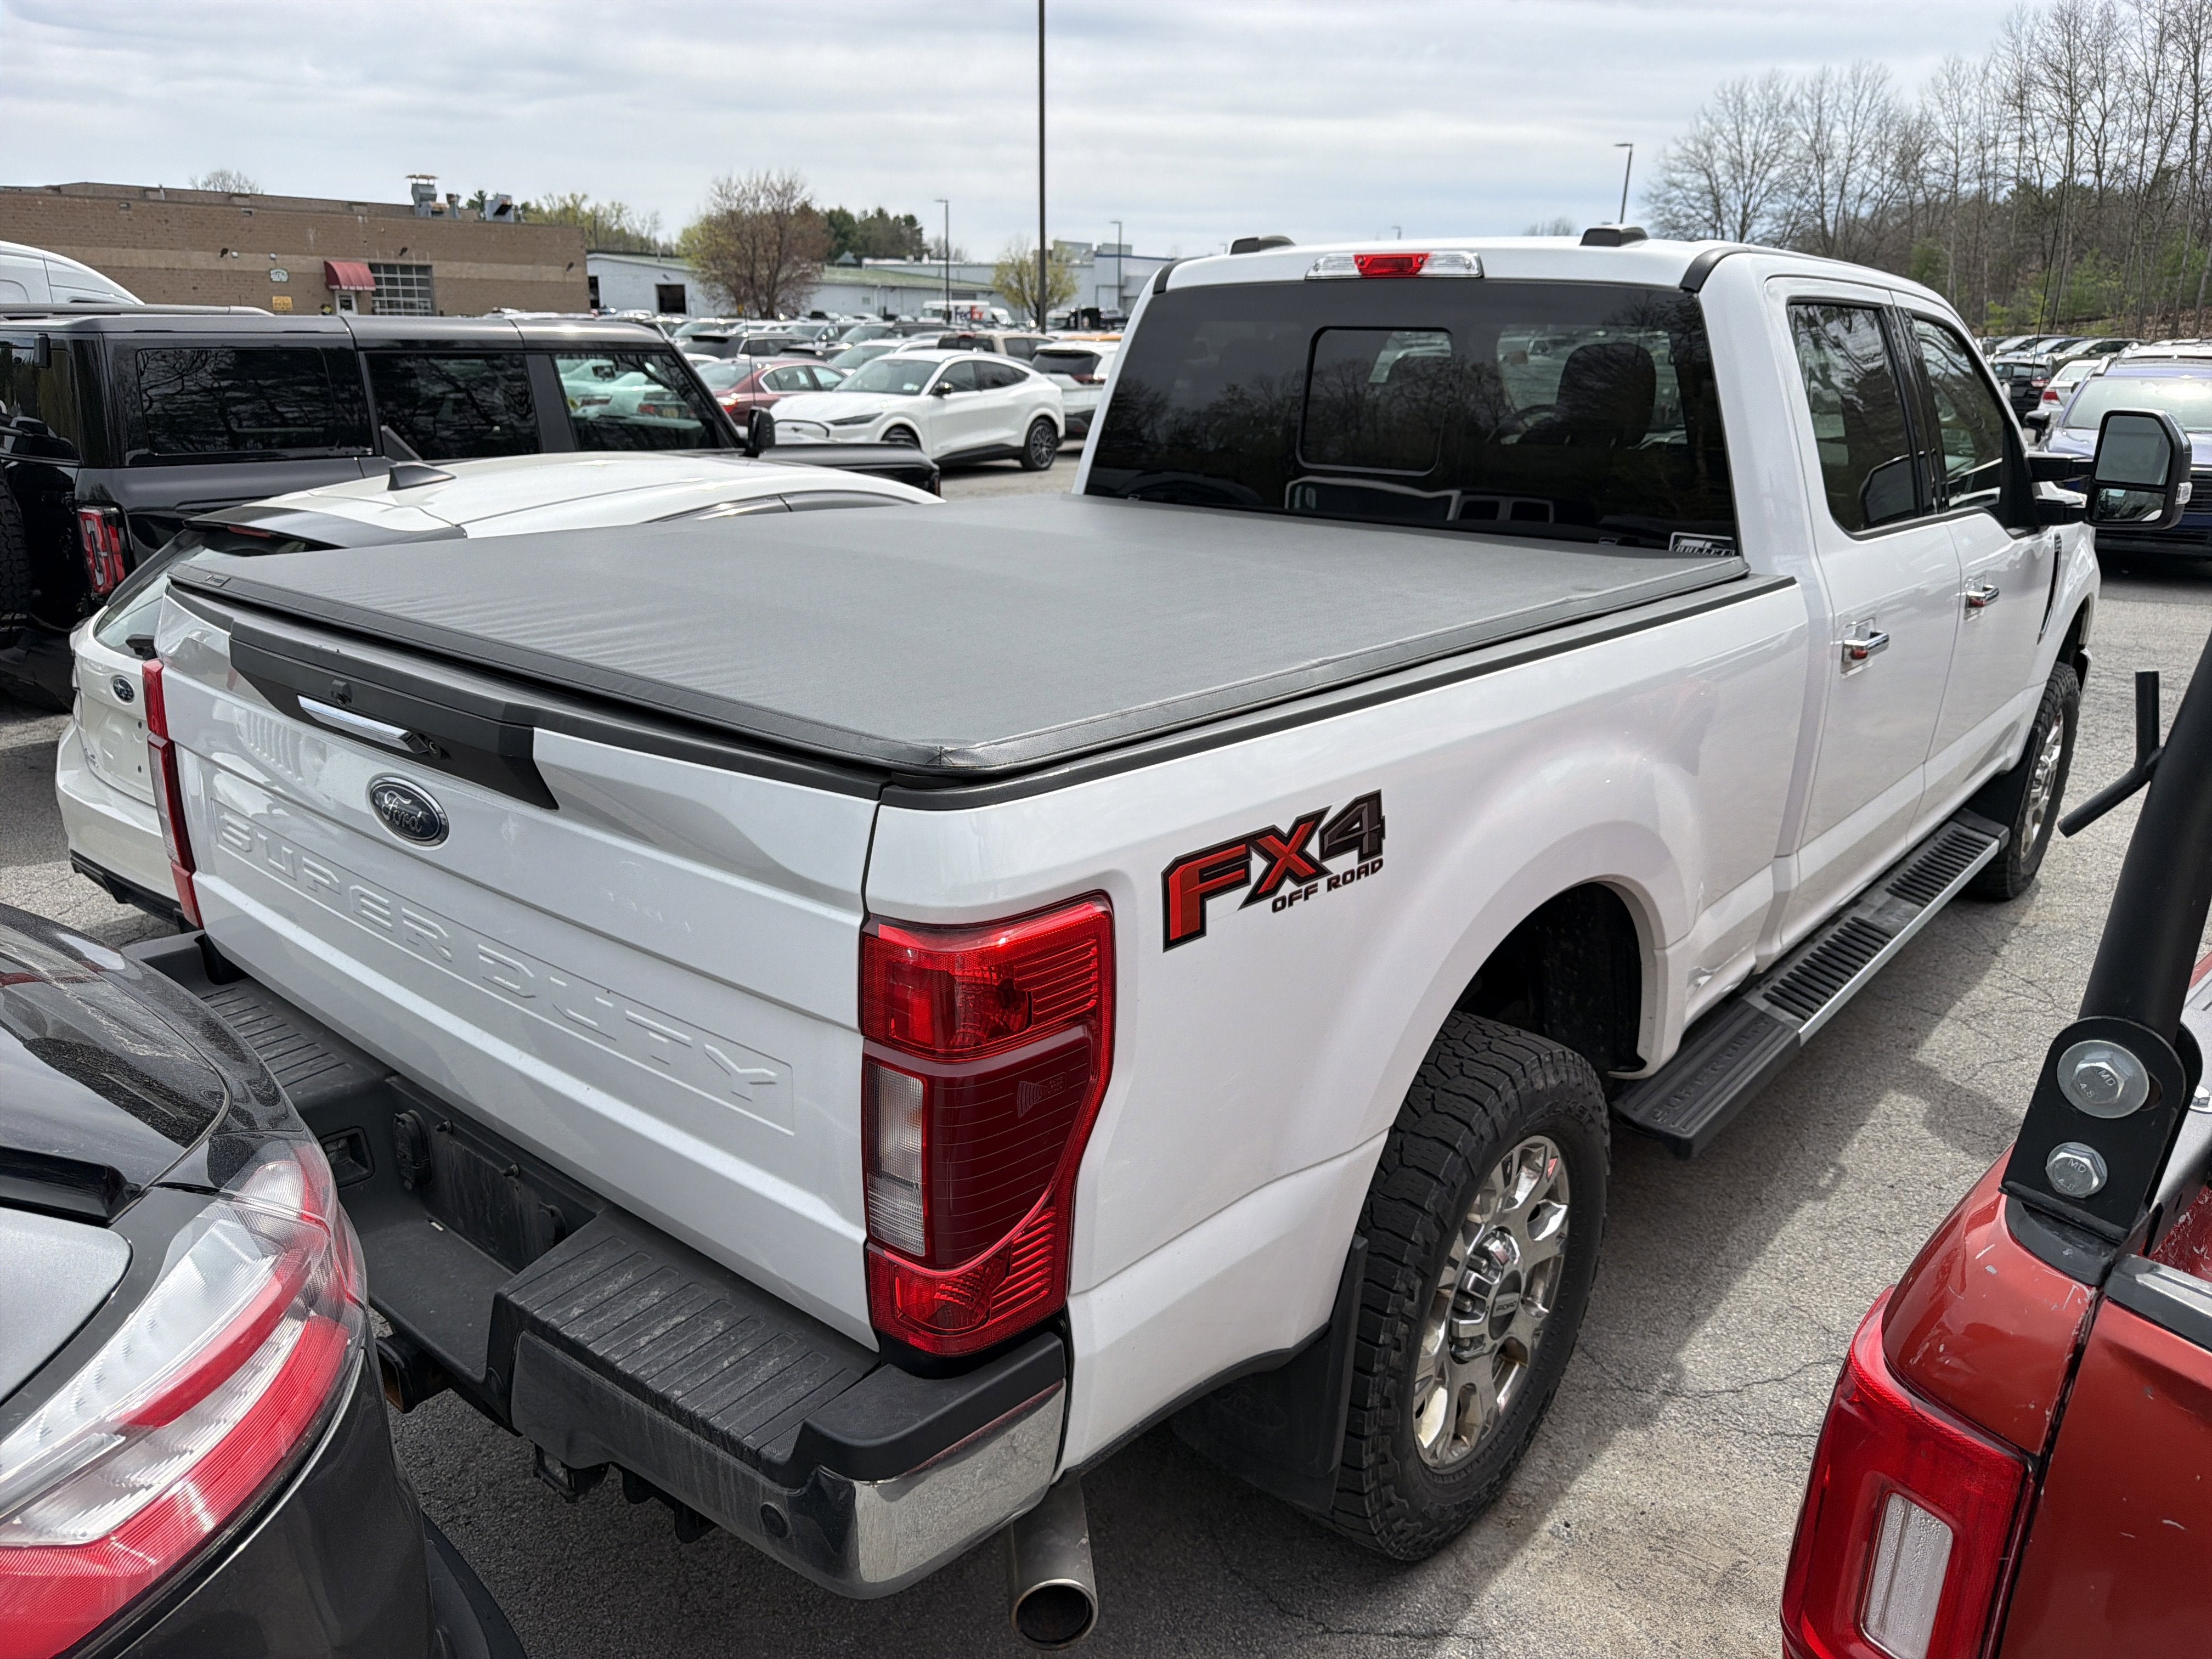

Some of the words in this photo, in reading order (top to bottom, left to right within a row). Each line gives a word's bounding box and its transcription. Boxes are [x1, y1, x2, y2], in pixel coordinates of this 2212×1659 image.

[955, 305, 984, 321] FedEx
[381, 790, 424, 834] Ford
[1161, 788, 1385, 952] FX4
[1272, 883, 1318, 913] OFF
[1327, 858, 1384, 893] ROAD
[219, 812, 453, 963] SUPER
[477, 942, 778, 1103] DUTY
[2097, 1069, 2116, 1087] MD
[2068, 1158, 2086, 1173] MD
[1496, 1300, 1517, 1312] FORD
